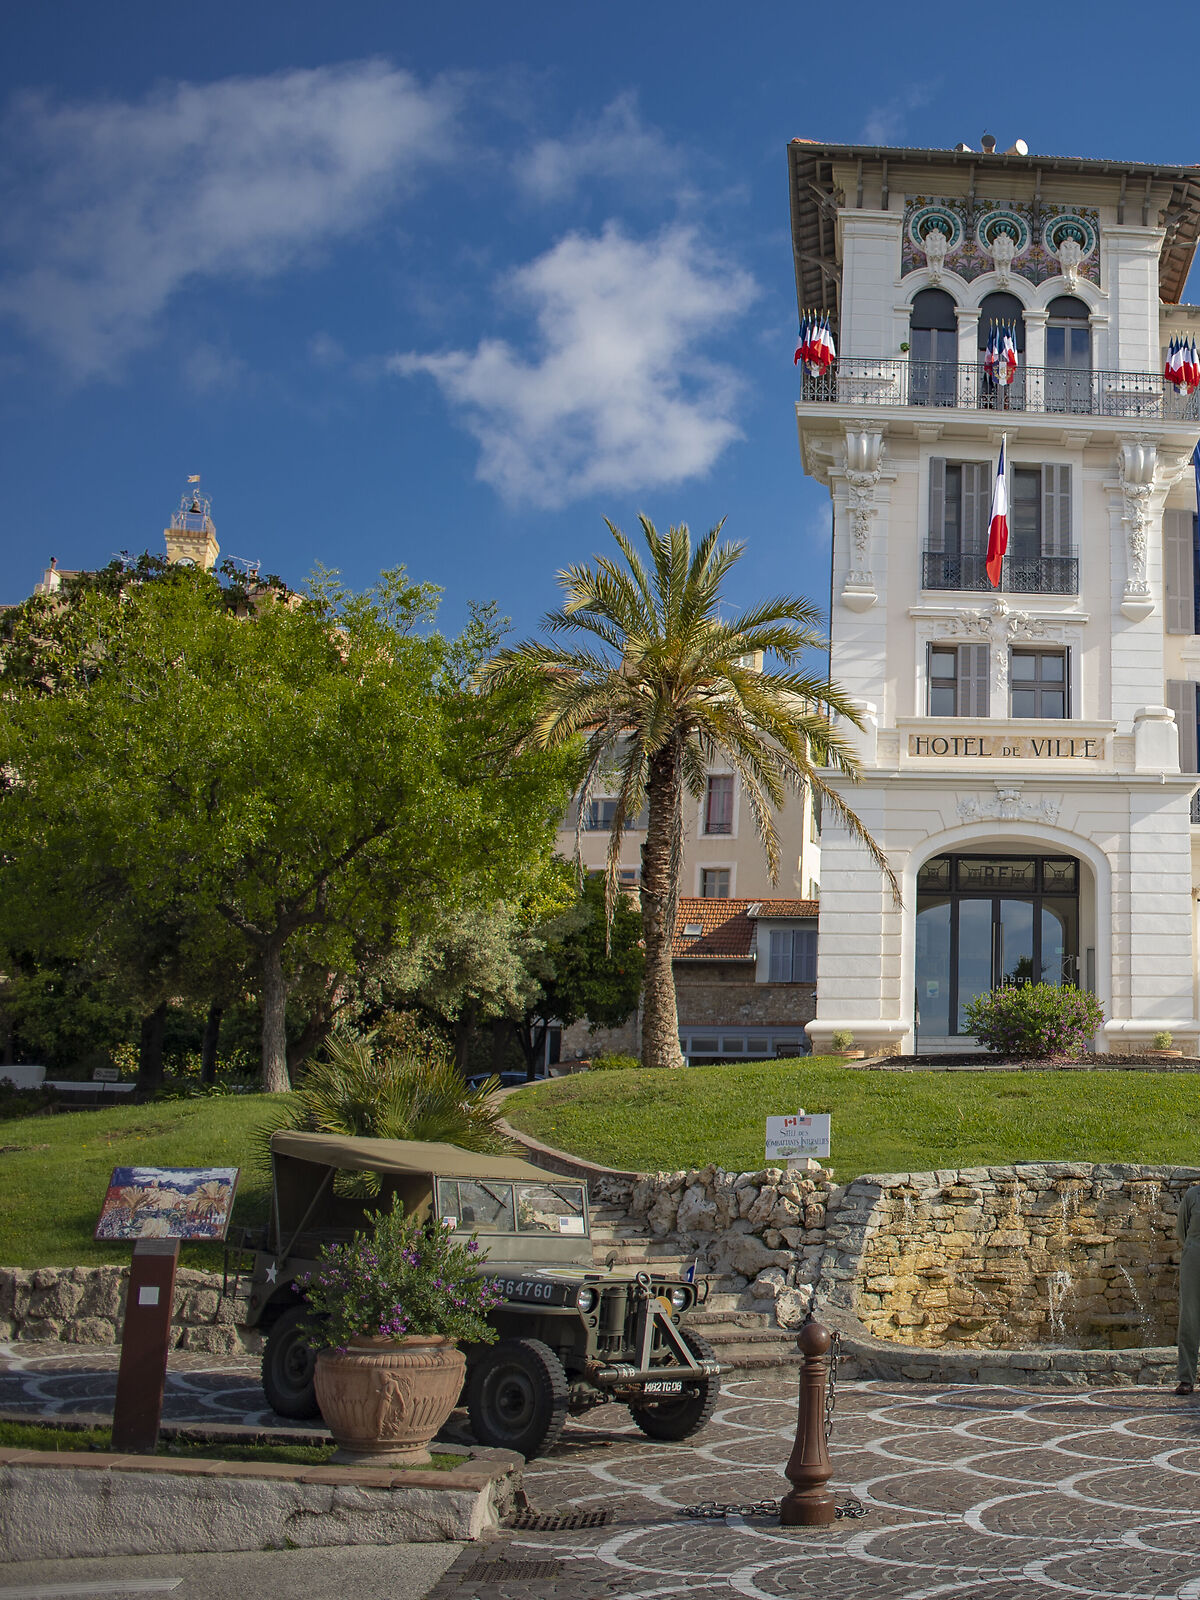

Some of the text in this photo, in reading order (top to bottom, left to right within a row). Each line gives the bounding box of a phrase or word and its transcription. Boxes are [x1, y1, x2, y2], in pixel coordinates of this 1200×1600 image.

[916, 737, 1098, 758] HOTEL DE VILLE
